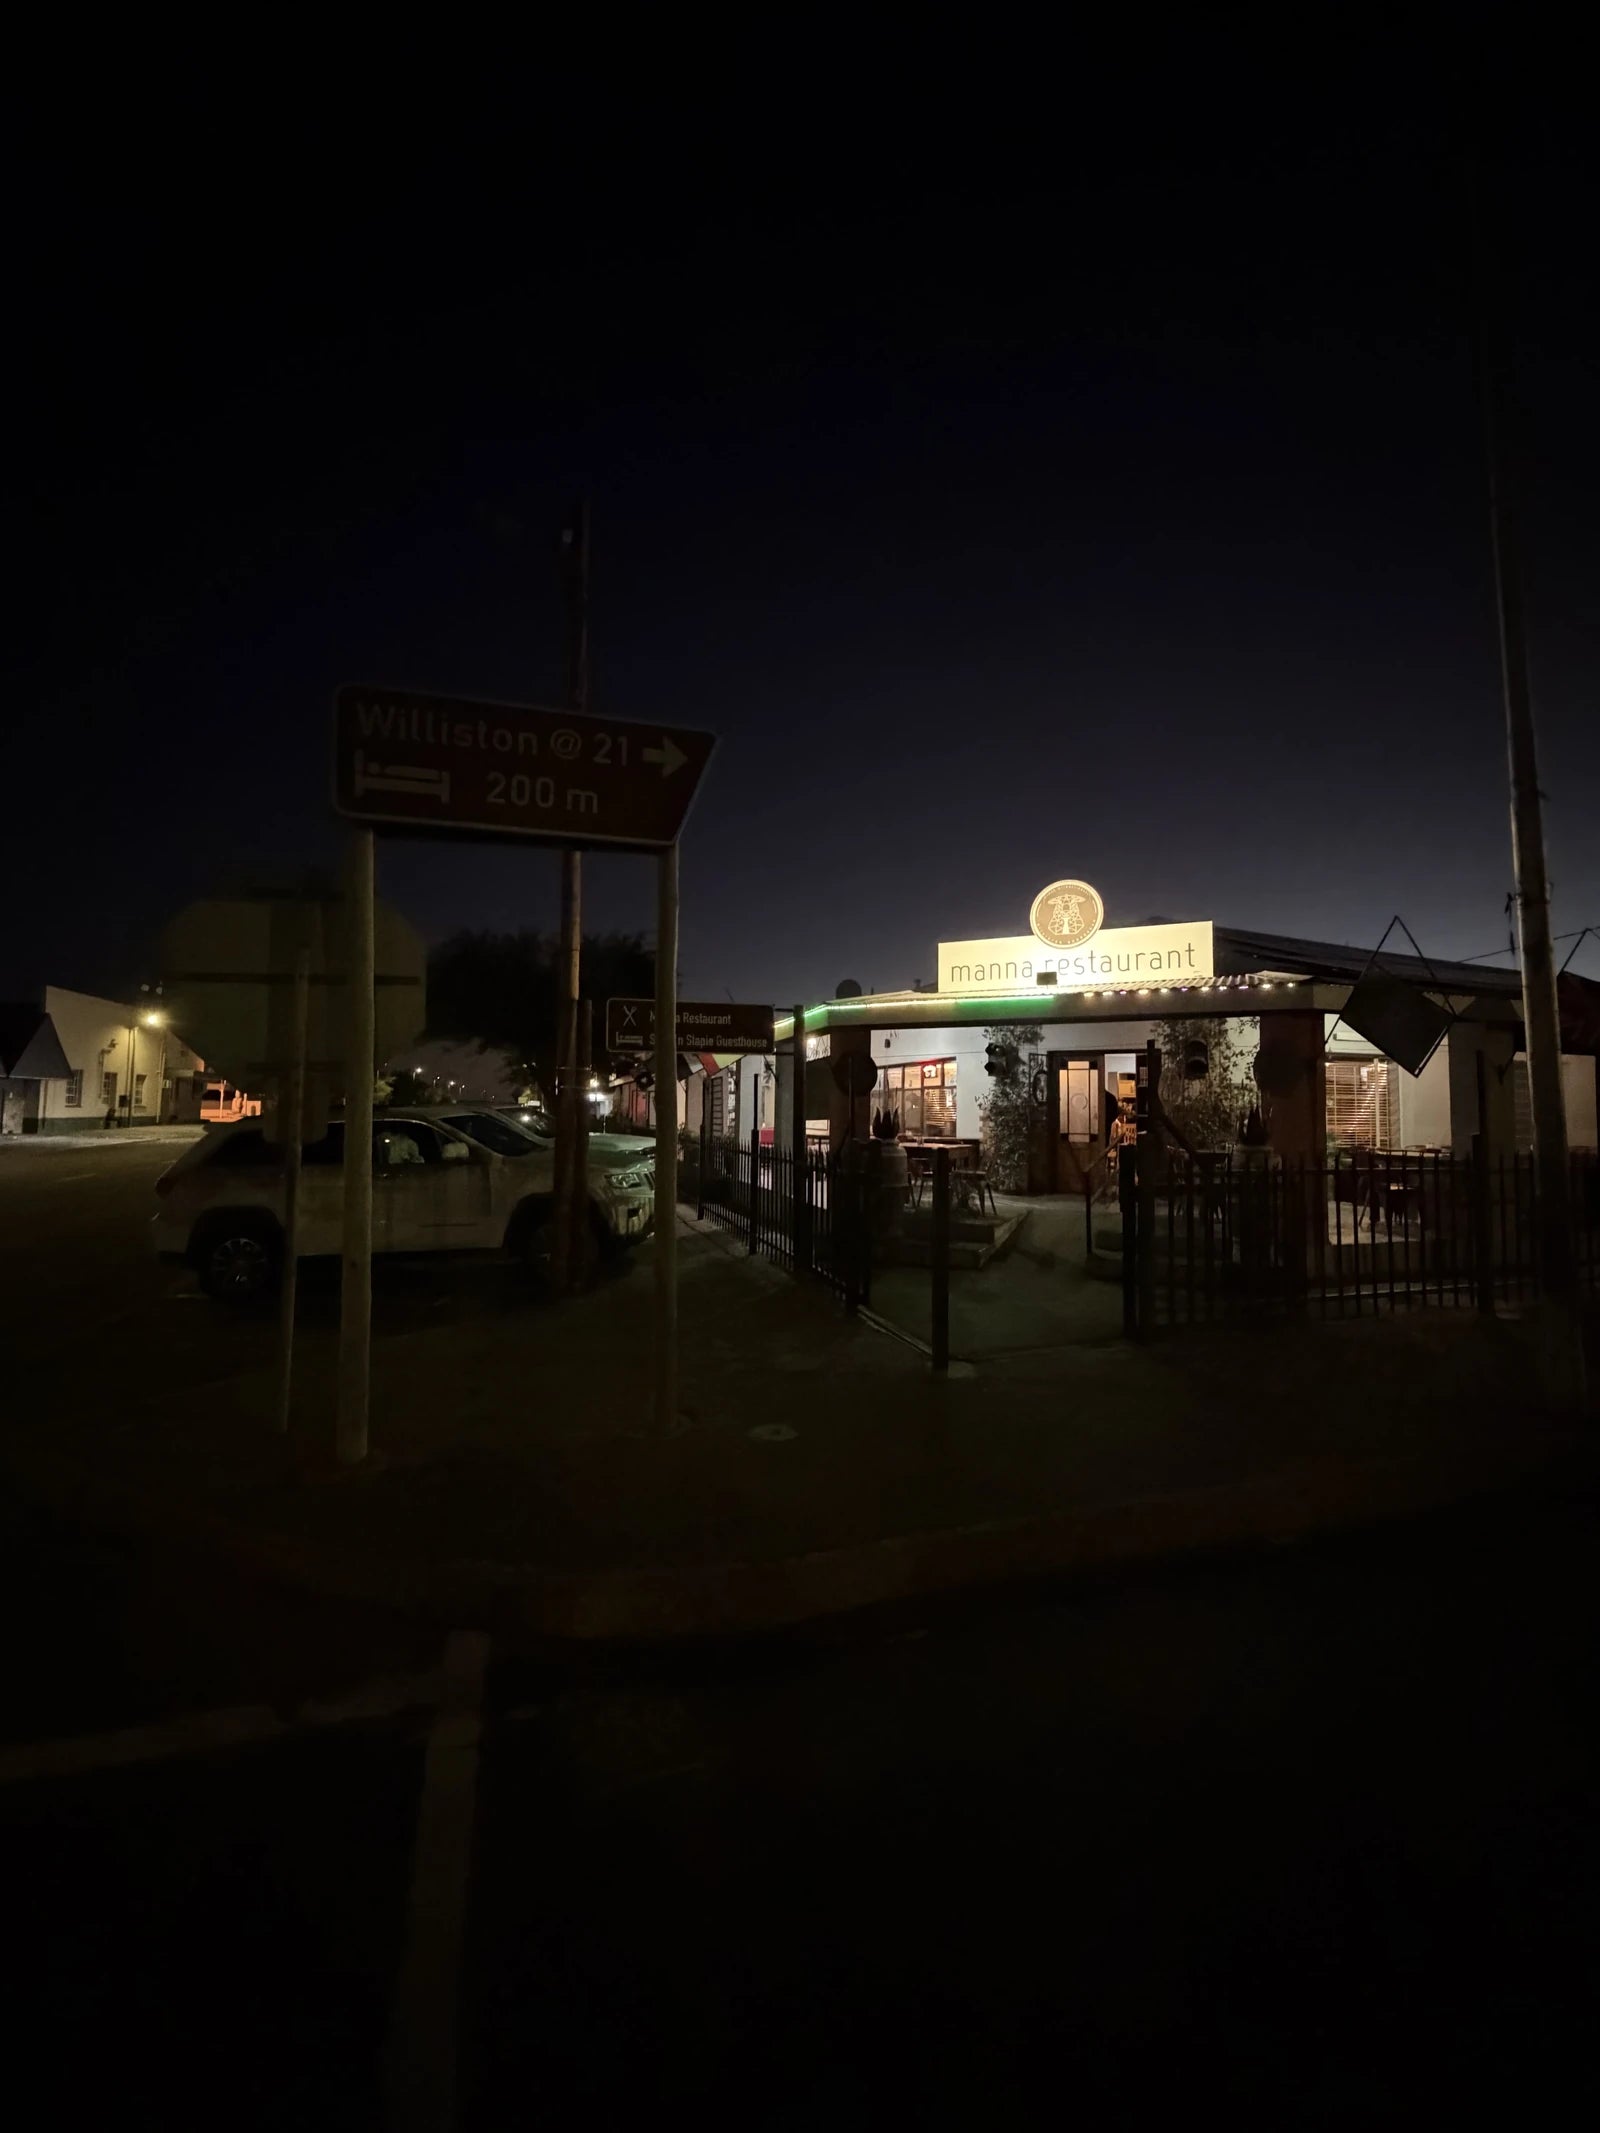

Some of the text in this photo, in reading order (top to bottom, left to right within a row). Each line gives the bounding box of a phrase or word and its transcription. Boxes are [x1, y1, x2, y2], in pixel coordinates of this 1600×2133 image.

[354, 701, 629, 767] Williston @ 21
[485, 770, 599, 815] 200 m
[951, 942, 1196, 983] manna restaurant
[682, 1012, 732, 1025] Restaurant
[716, 1034, 768, 1048] Guesthouse
